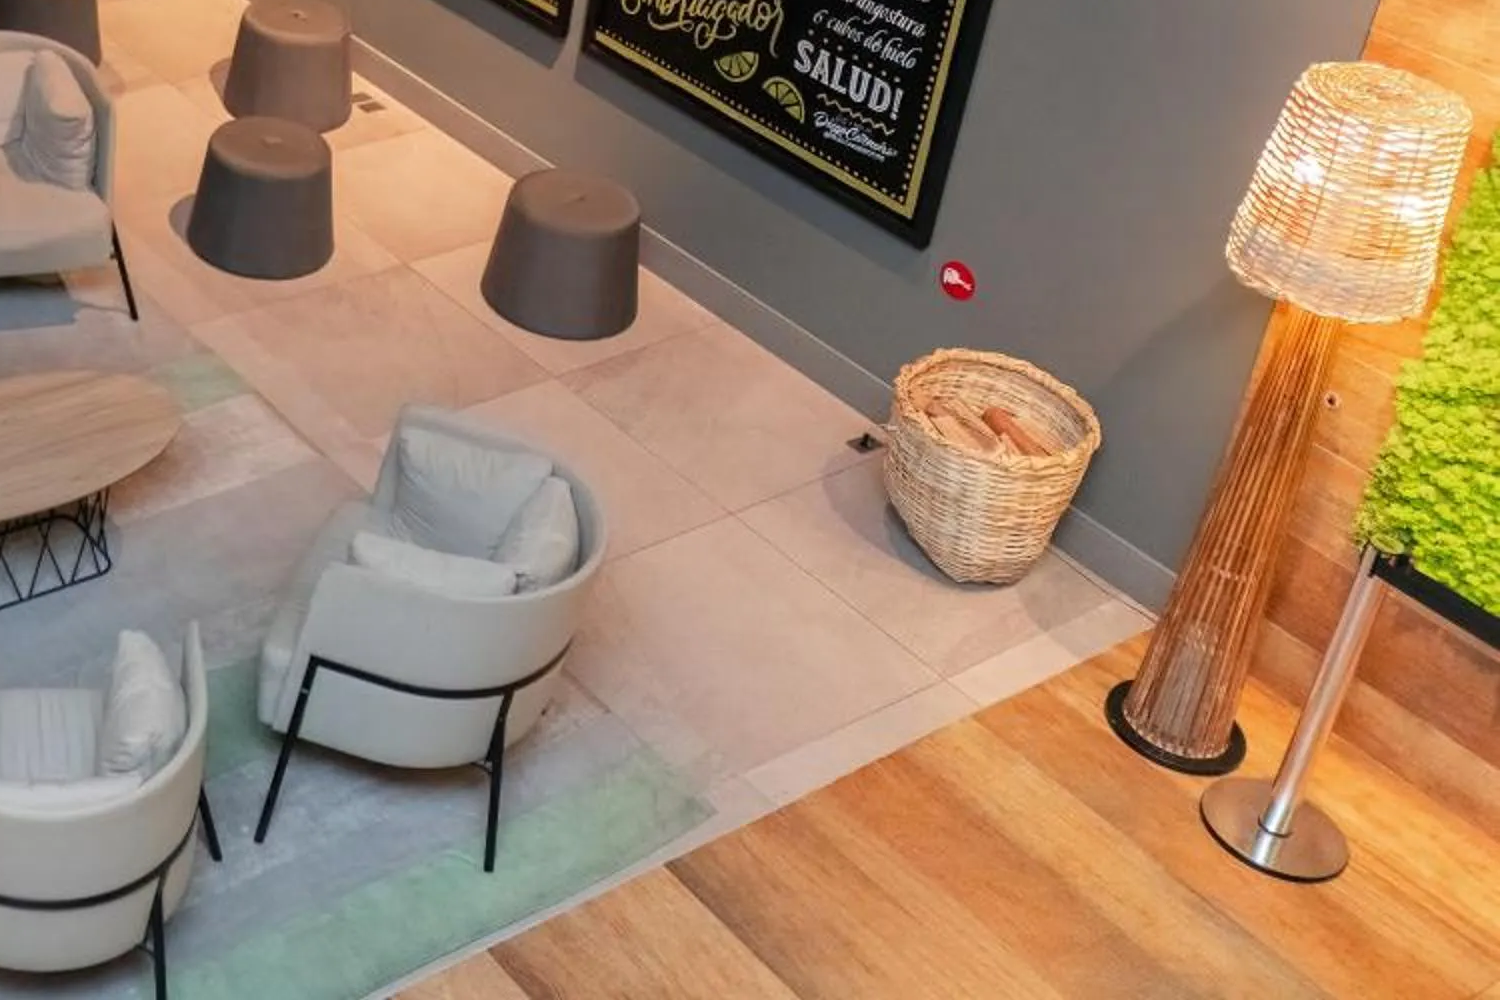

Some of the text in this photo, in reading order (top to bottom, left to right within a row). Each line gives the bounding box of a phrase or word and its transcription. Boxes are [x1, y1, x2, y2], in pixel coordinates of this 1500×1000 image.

[812, 9, 924, 70] 6 cubos de hielo
[793, 39, 905, 121] SALUD!
